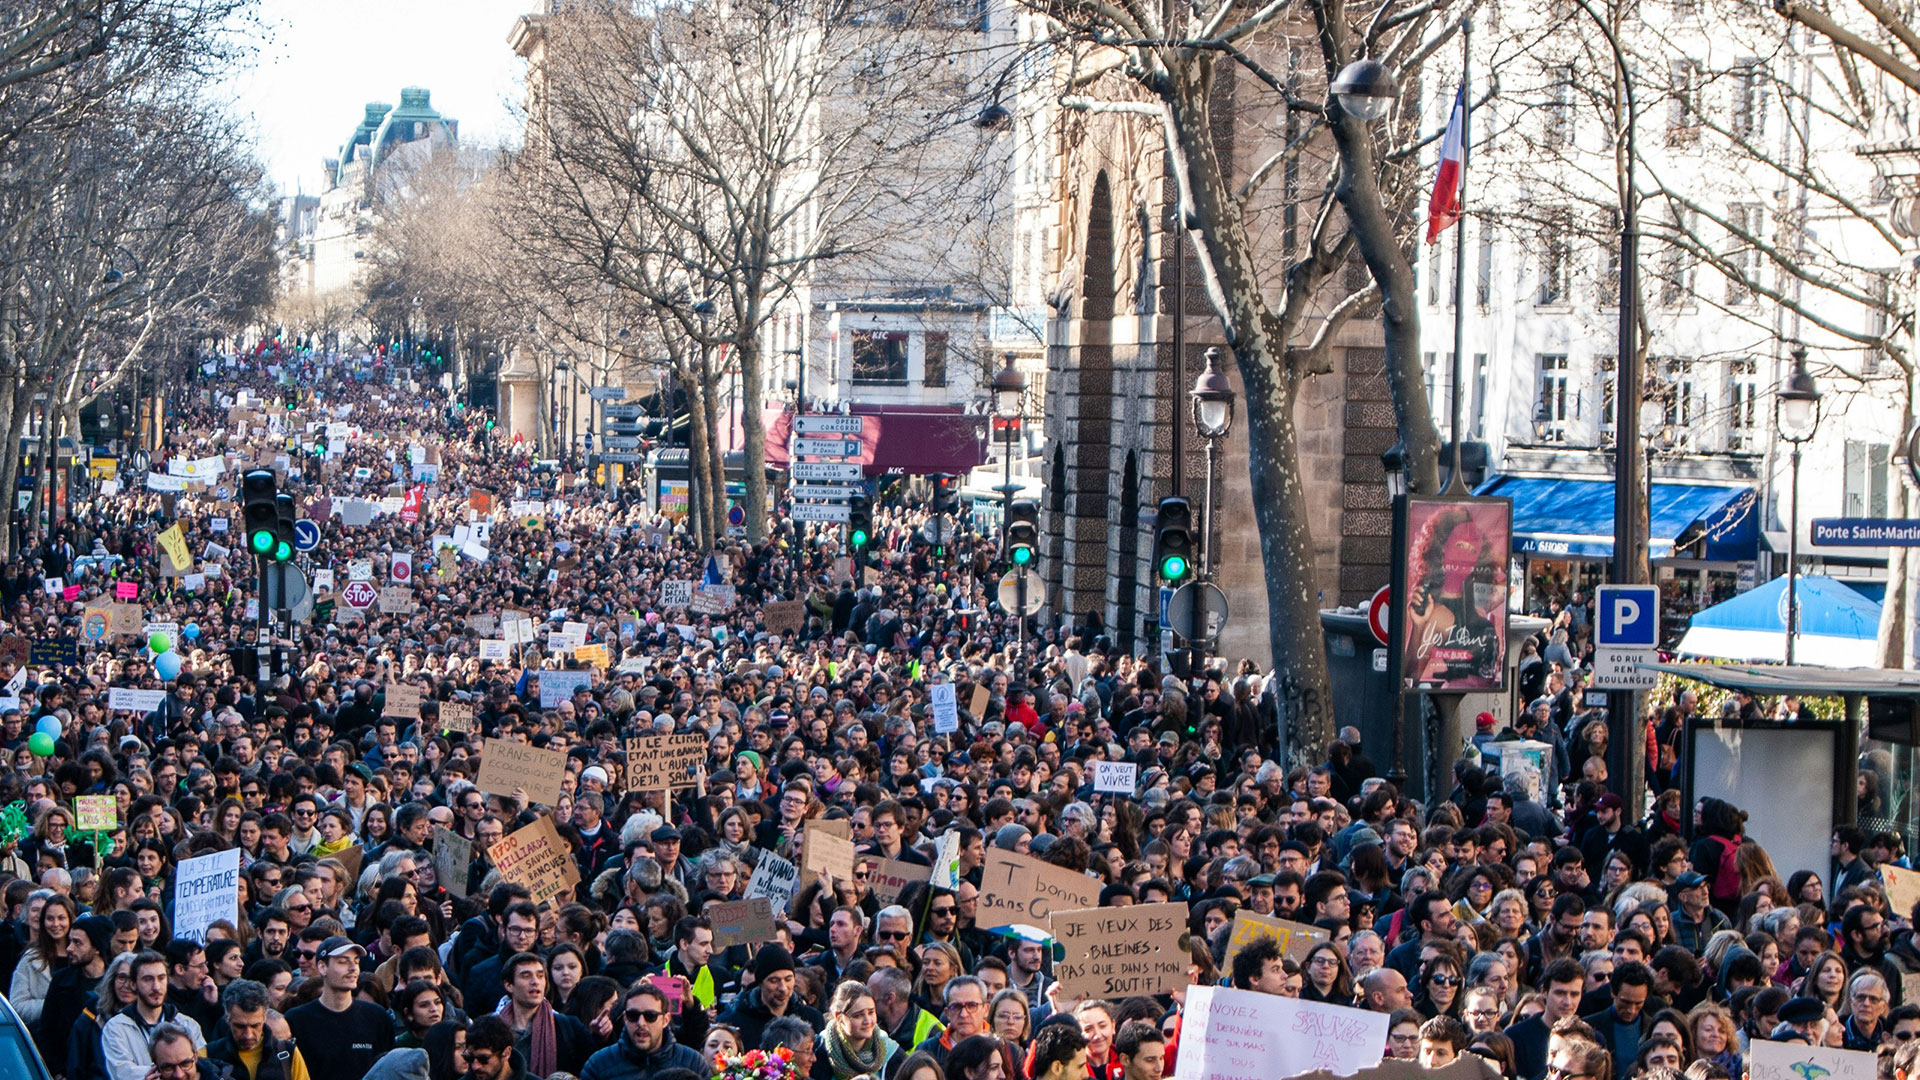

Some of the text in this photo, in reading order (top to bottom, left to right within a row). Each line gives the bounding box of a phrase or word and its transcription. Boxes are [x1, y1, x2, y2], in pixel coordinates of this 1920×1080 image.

[872, 331, 889, 340] KFC
[848, 444, 856, 453] P
[888, 466, 904, 474] KFC
[1818, 526, 1849, 539] Porte
[1522, 541, 1569, 553] AL SHOES
[346, 590, 373, 602] STOP
[1614, 598, 1640, 635] P
[1417, 620, 1444, 659] Yes
[1445, 624, 1456, 646] I
[1625, 655, 1644, 663] RUE
[1598, 676, 1654, 684] BOULANGER
[630, 735, 703, 750] SI LE CLIMAT
[629, 746, 703, 761] ETAIT UNE BANQUE
[488, 760, 556, 780] ECOLOGIQUE
[634, 763, 652, 774] ON
[1100, 765, 1111, 773] ON
[632, 772, 696, 788] DEJA SAUV
[492, 837, 518, 859] 1700
[497, 836, 548, 872] MILLIARDS
[526, 848, 555, 869] SAUVER
[528, 854, 566, 880] BANQUES
[185, 862, 194, 876] LA
[769, 858, 794, 881] QUAND
[178, 868, 237, 898] TEMPERATURE
[529, 867, 567, 891] OUR LA
[998, 861, 1090, 906] T bonne
[536, 881, 560, 900] TERRE
[1066, 918, 1173, 937] JE VEUX DES
[1061, 962, 1180, 979] PAS QUE DANS MON
[1194, 1001, 1258, 1018] ENVOYEZ
[1292, 1010, 1368, 1046] SAUVEZ
[1243, 1042, 1266, 1052] MARS
[1313, 1040, 1340, 1062] LA
[1230, 1057, 1256, 1069] TOUS
